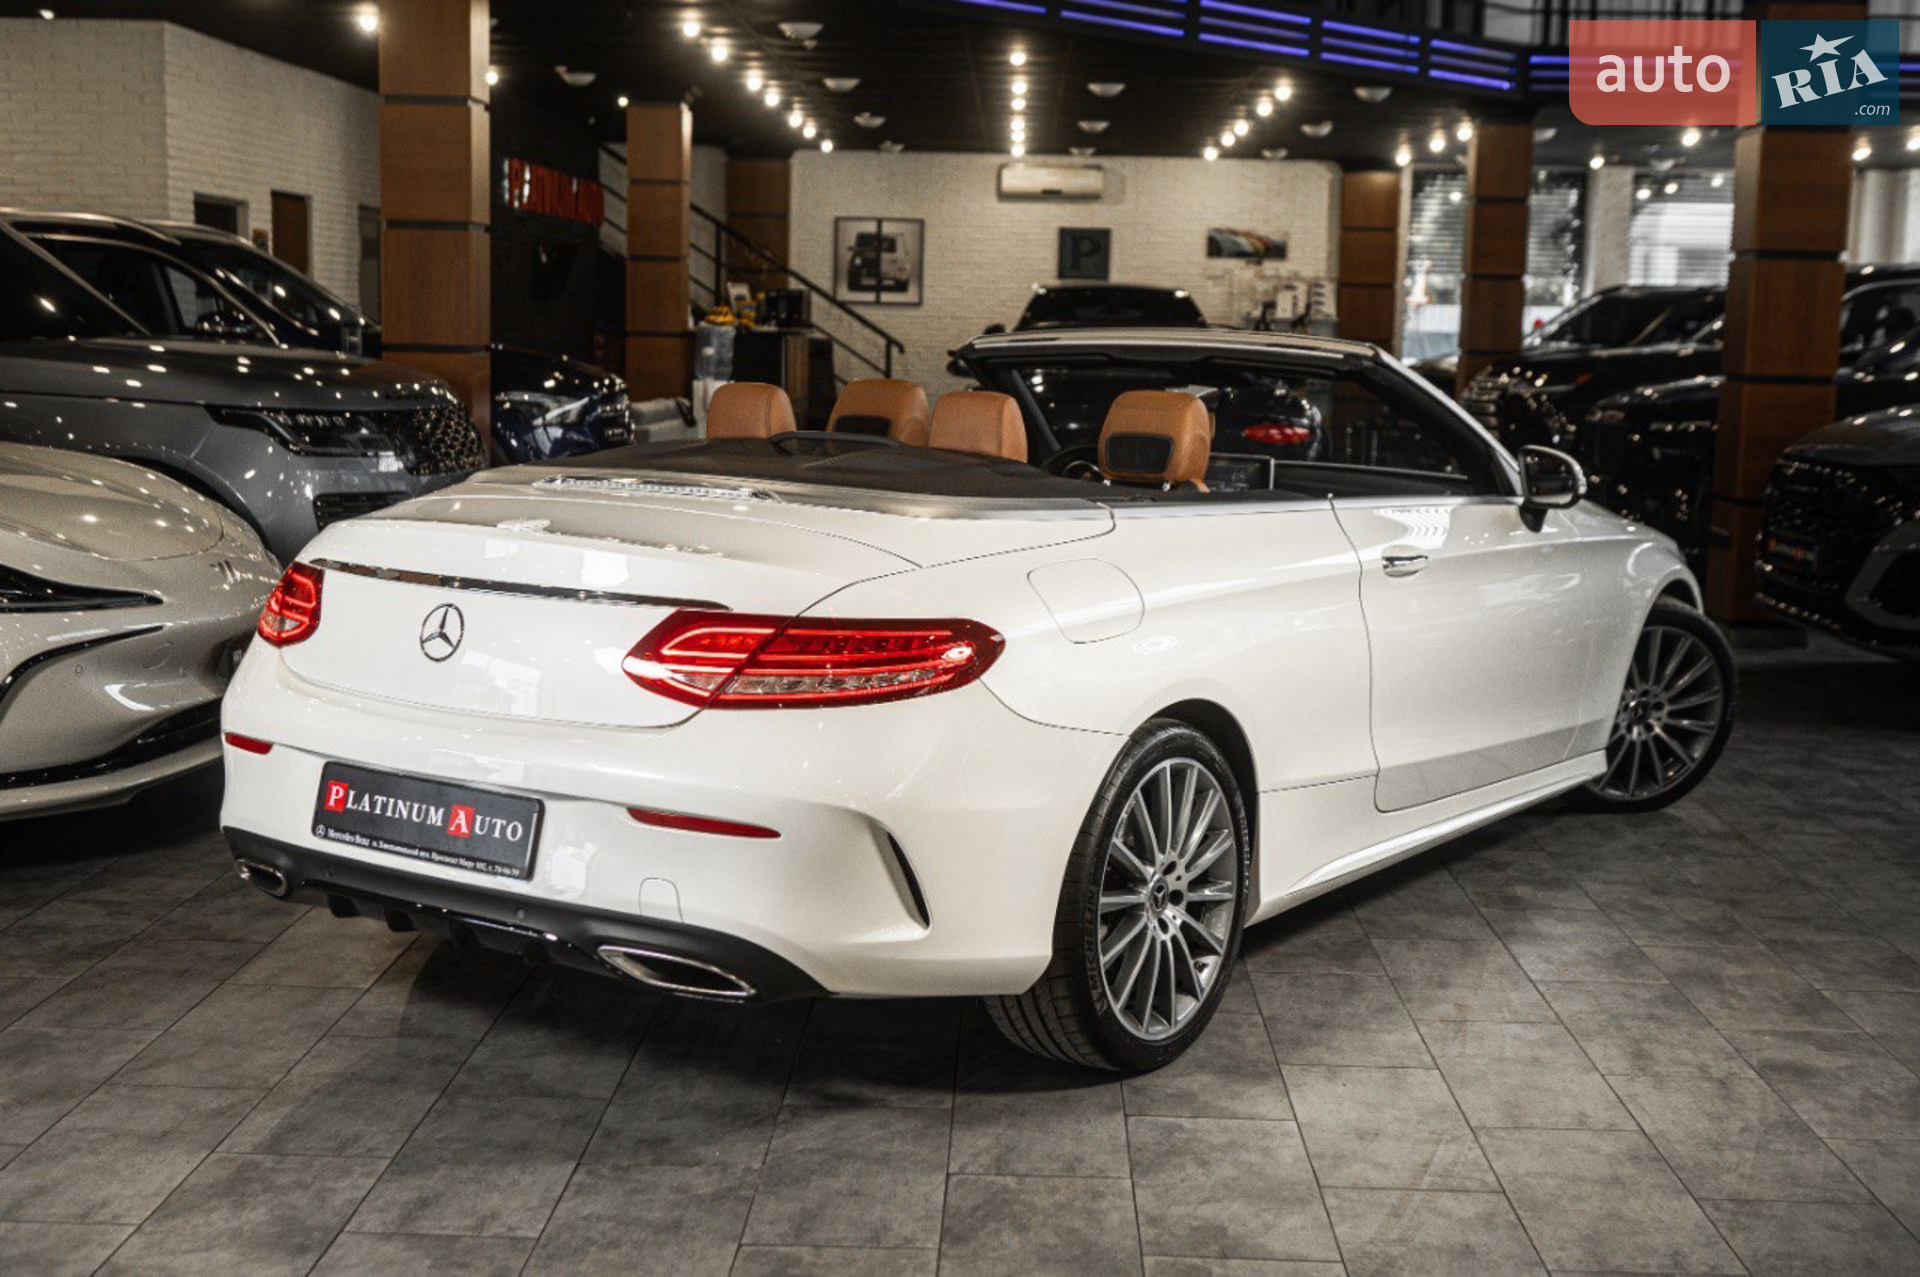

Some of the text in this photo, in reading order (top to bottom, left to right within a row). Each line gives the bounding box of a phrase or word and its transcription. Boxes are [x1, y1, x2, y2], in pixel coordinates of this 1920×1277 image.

[1069, 236, 1102, 271] P
[329, 785, 523, 842] PLATINUM AUTO
[1084, 884, 1101, 990] MICHELIN
